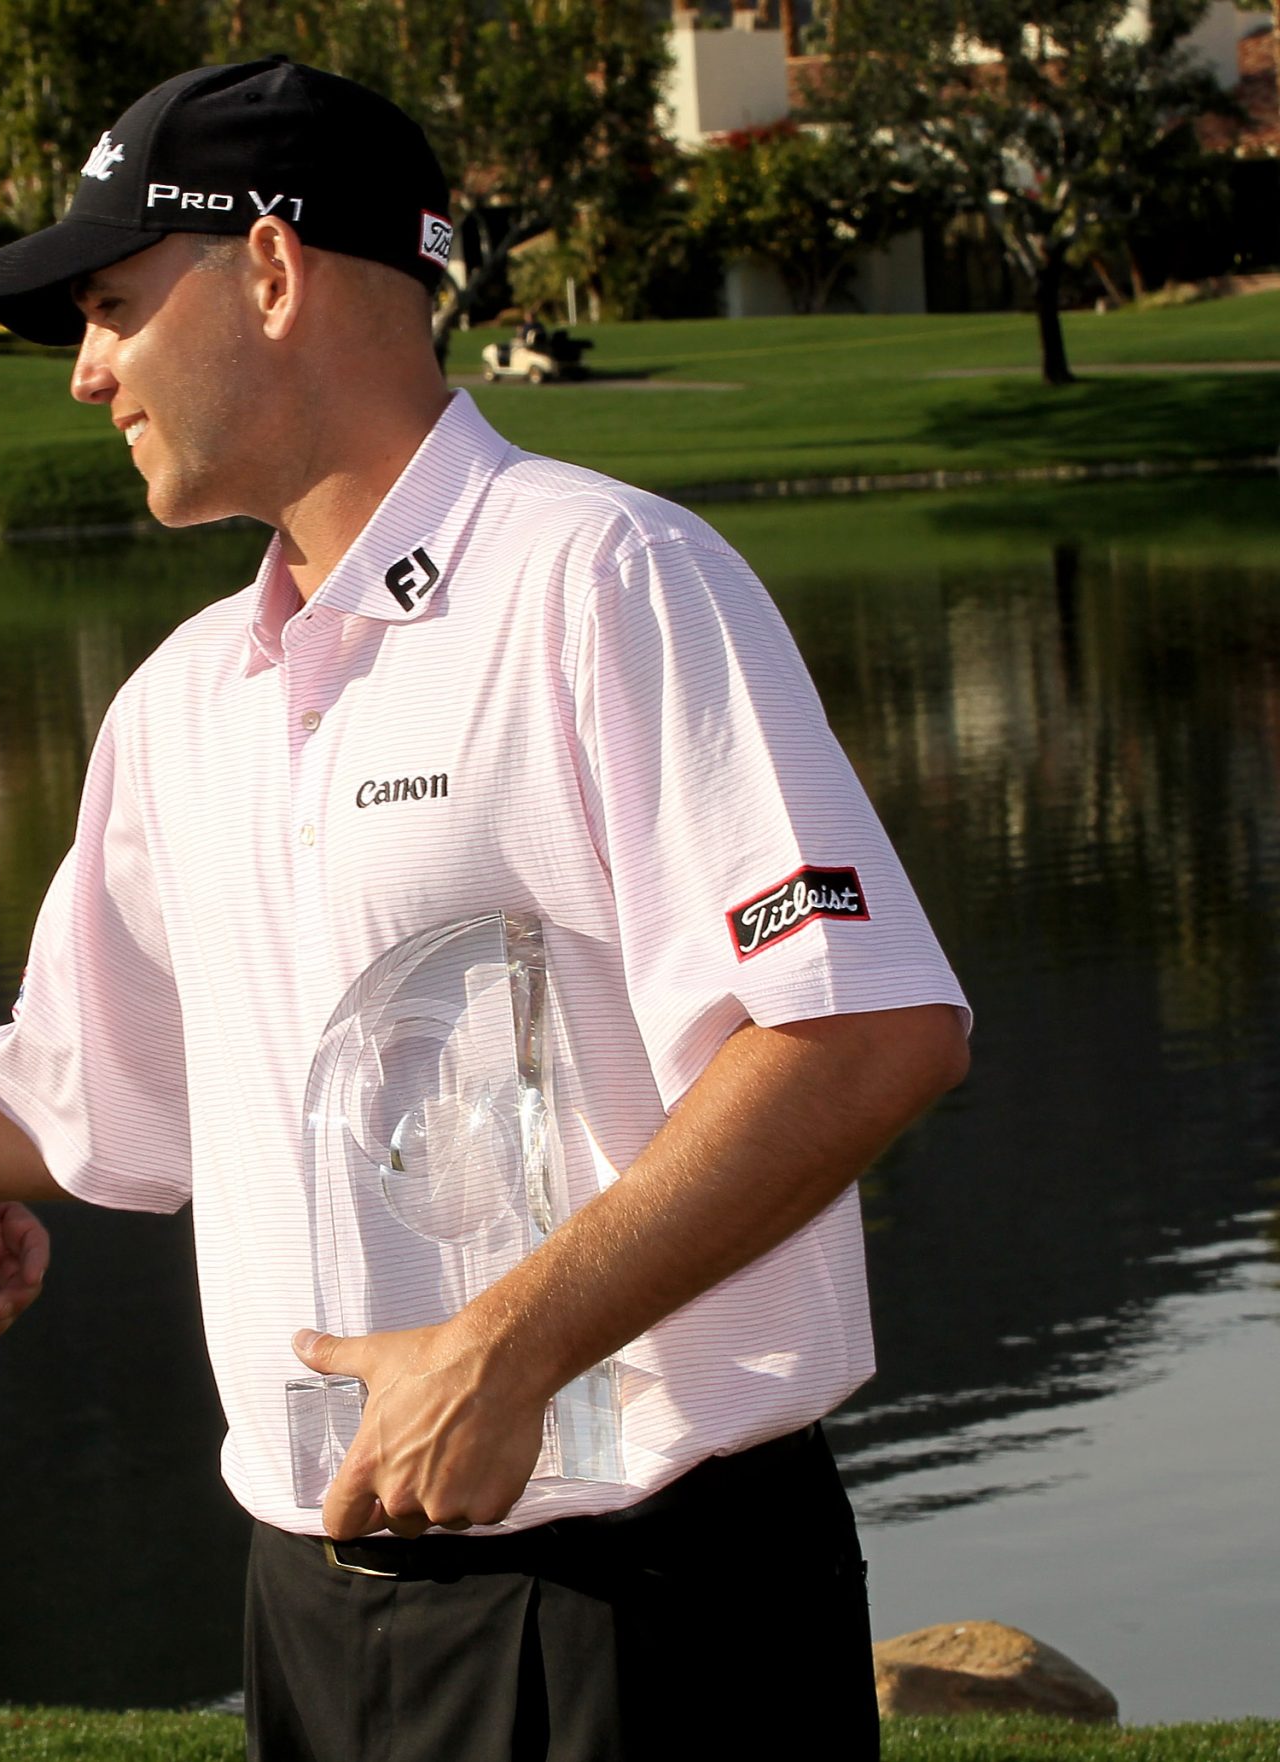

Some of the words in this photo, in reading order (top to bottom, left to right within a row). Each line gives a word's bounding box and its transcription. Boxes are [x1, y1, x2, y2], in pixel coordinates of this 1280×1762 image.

[248, 190, 304, 222] V1
[384, 546, 440, 613] FJ
[356, 773, 449, 808] Canon
[739, 880, 859, 953] Titleist
